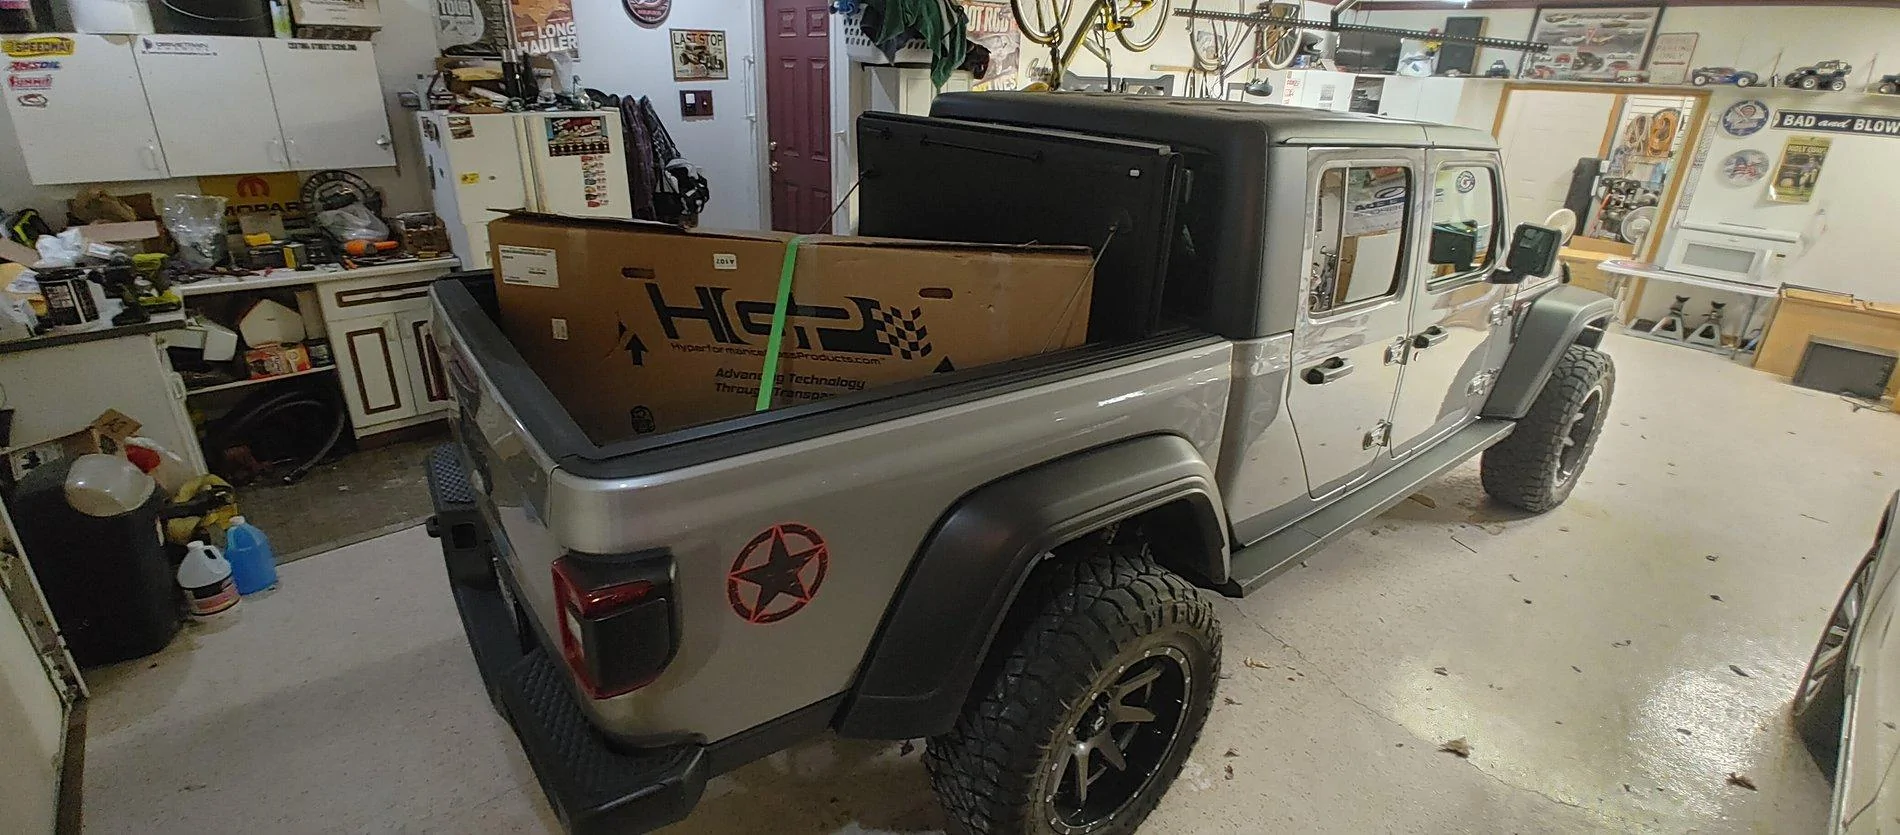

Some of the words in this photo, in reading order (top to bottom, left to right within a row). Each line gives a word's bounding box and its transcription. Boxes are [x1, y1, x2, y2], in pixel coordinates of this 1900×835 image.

[964, 5, 984, 32] OT
[537, 22, 577, 39] LONG
[673, 32, 697, 45] LAST
[698, 33, 723, 46] STOP
[516, 35, 579, 56] HAULER
[1783, 114, 1816, 127] BAD
[1818, 119, 1851, 128] and
[715, 383, 761, 397] Throug
[789, 373, 865, 390] Technology
